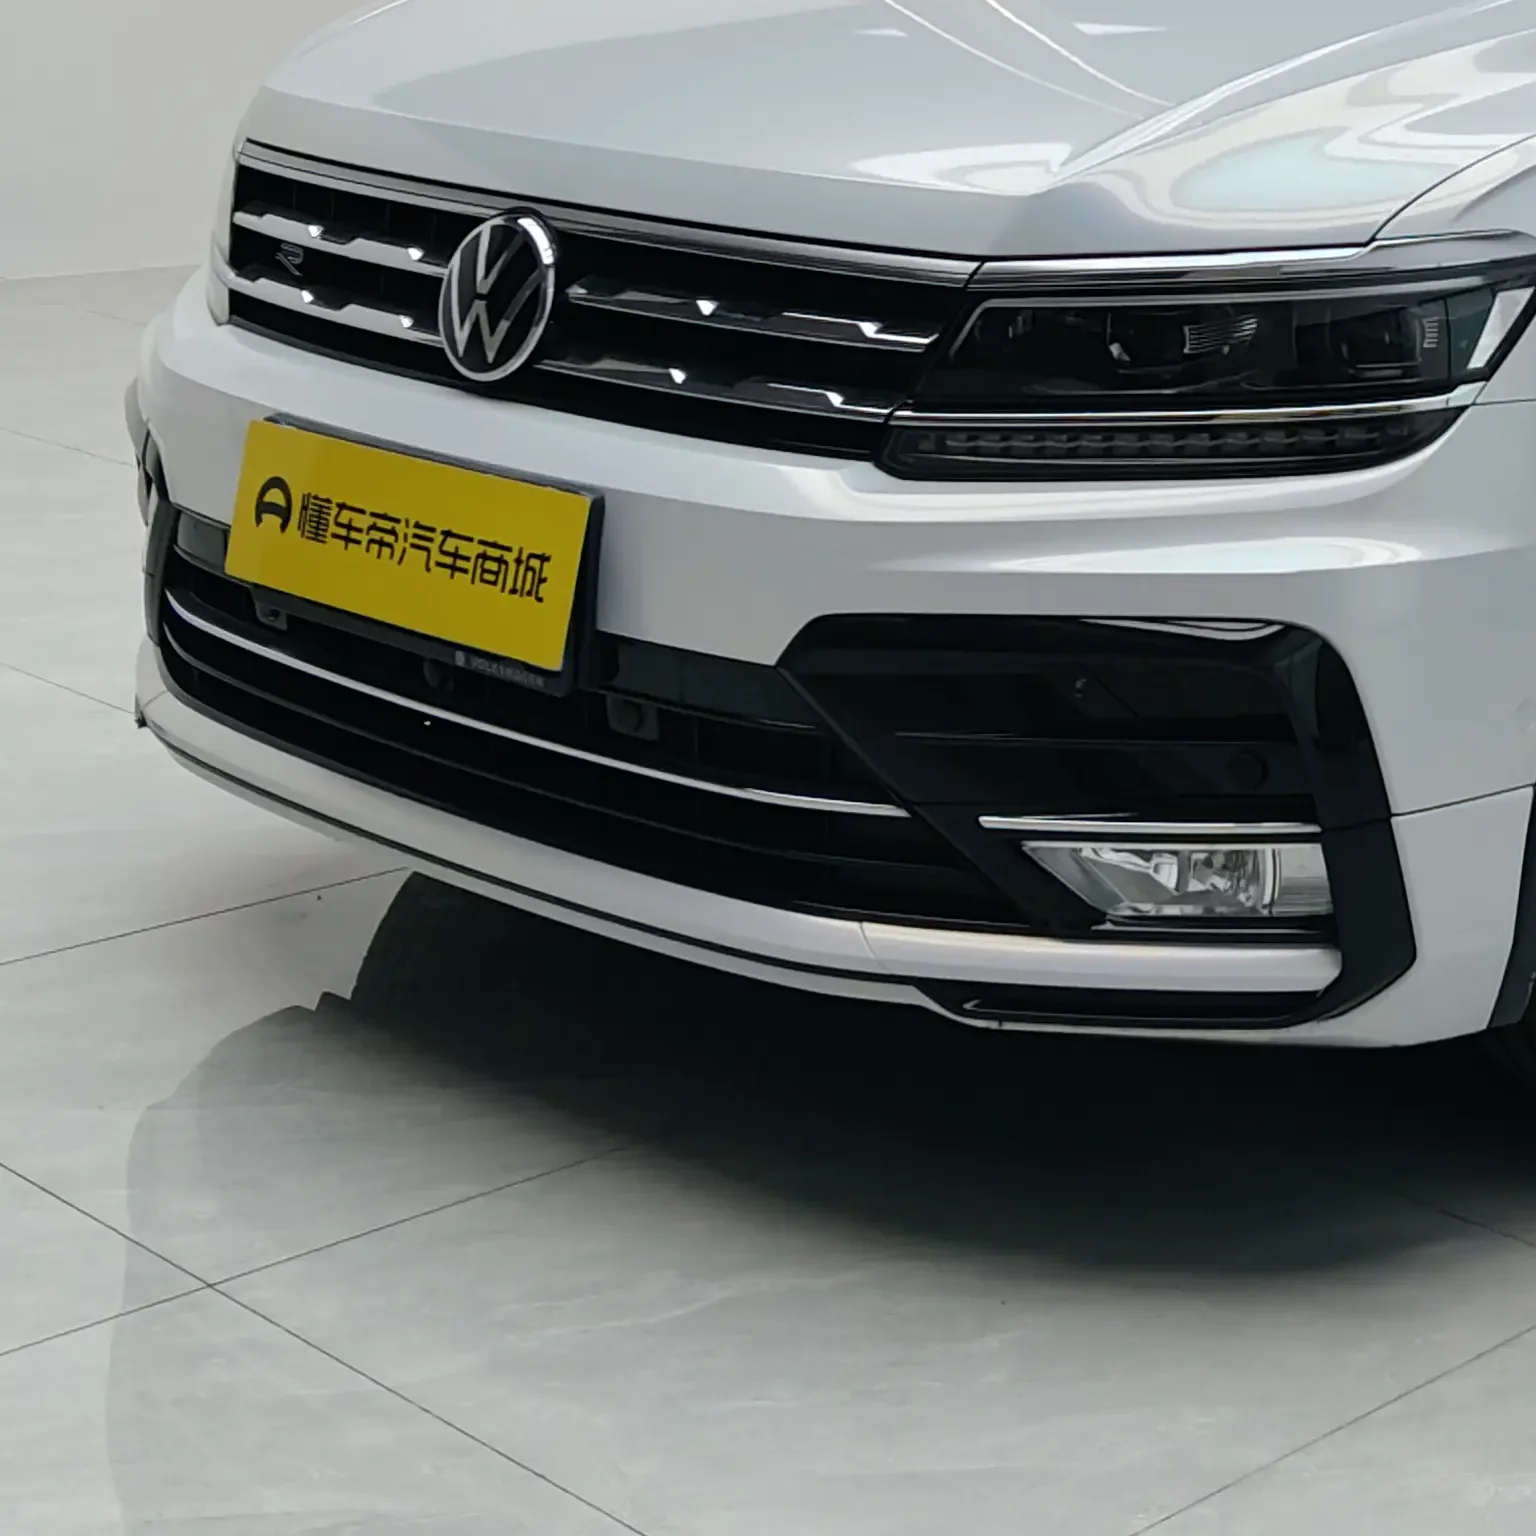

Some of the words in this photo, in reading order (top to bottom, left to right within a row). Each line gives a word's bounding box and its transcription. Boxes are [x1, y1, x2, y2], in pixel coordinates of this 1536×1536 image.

[297, 492, 552, 603] 懂车帝汽车商城
